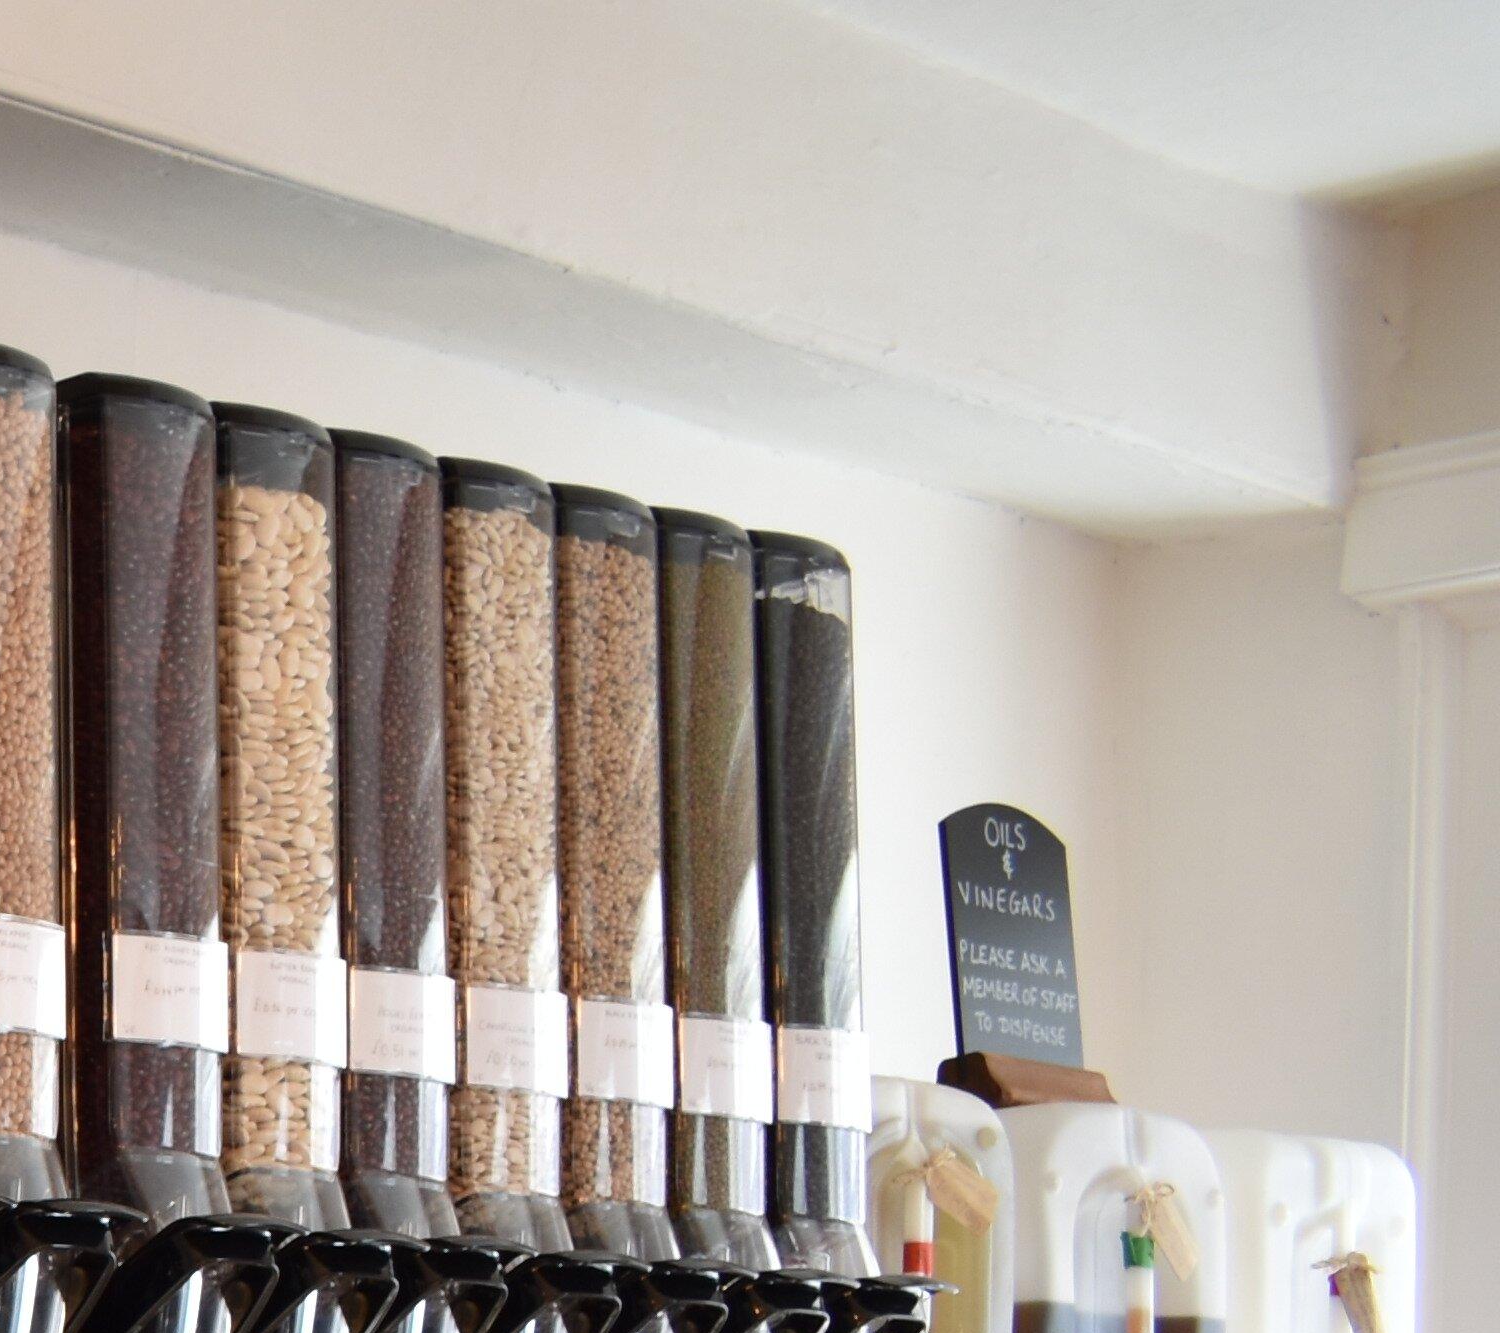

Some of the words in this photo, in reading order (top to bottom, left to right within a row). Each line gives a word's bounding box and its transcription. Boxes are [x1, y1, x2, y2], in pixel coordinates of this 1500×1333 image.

[983, 816, 1027, 852] OILS
[956, 880, 1056, 922] VINEGARS
[959, 938, 1018, 971] PLEASE
[1021, 952, 1051, 976] ASK
[1054, 959, 1068, 979] A
[961, 975, 1021, 1005] MEMBER
[1022, 986, 1039, 1008] OF
[1040, 990, 1078, 1014] STAFF
[974, 1010, 993, 1036] TO
[998, 1016, 1068, 1048] DISPENSE
